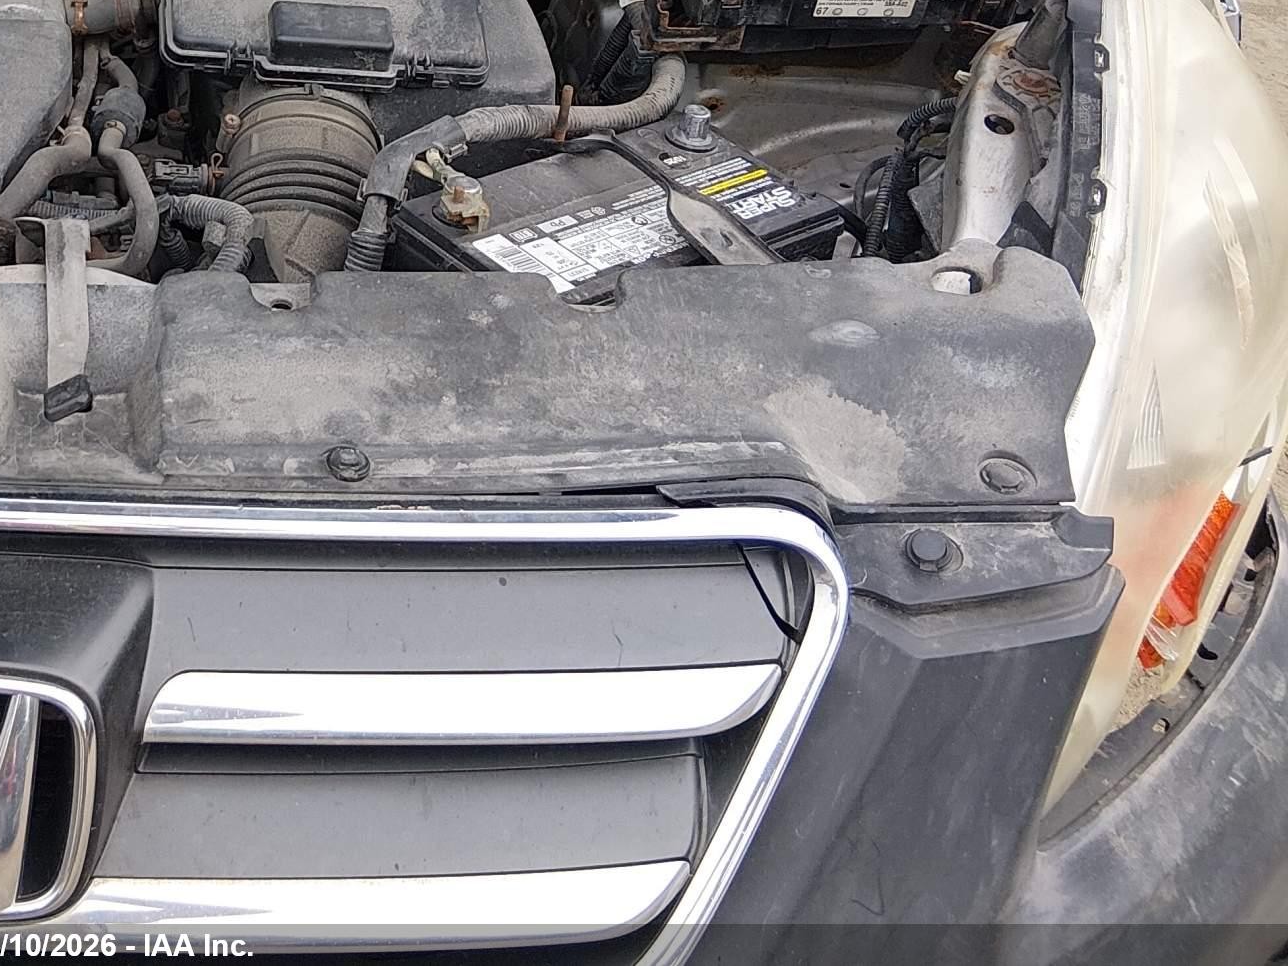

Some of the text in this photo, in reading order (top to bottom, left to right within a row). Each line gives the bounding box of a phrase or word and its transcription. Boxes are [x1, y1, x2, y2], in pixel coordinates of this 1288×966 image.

[815, 7, 829, 15] 67
[736, 197, 796, 220] SUPER
[549, 220, 567, 229] Pb
